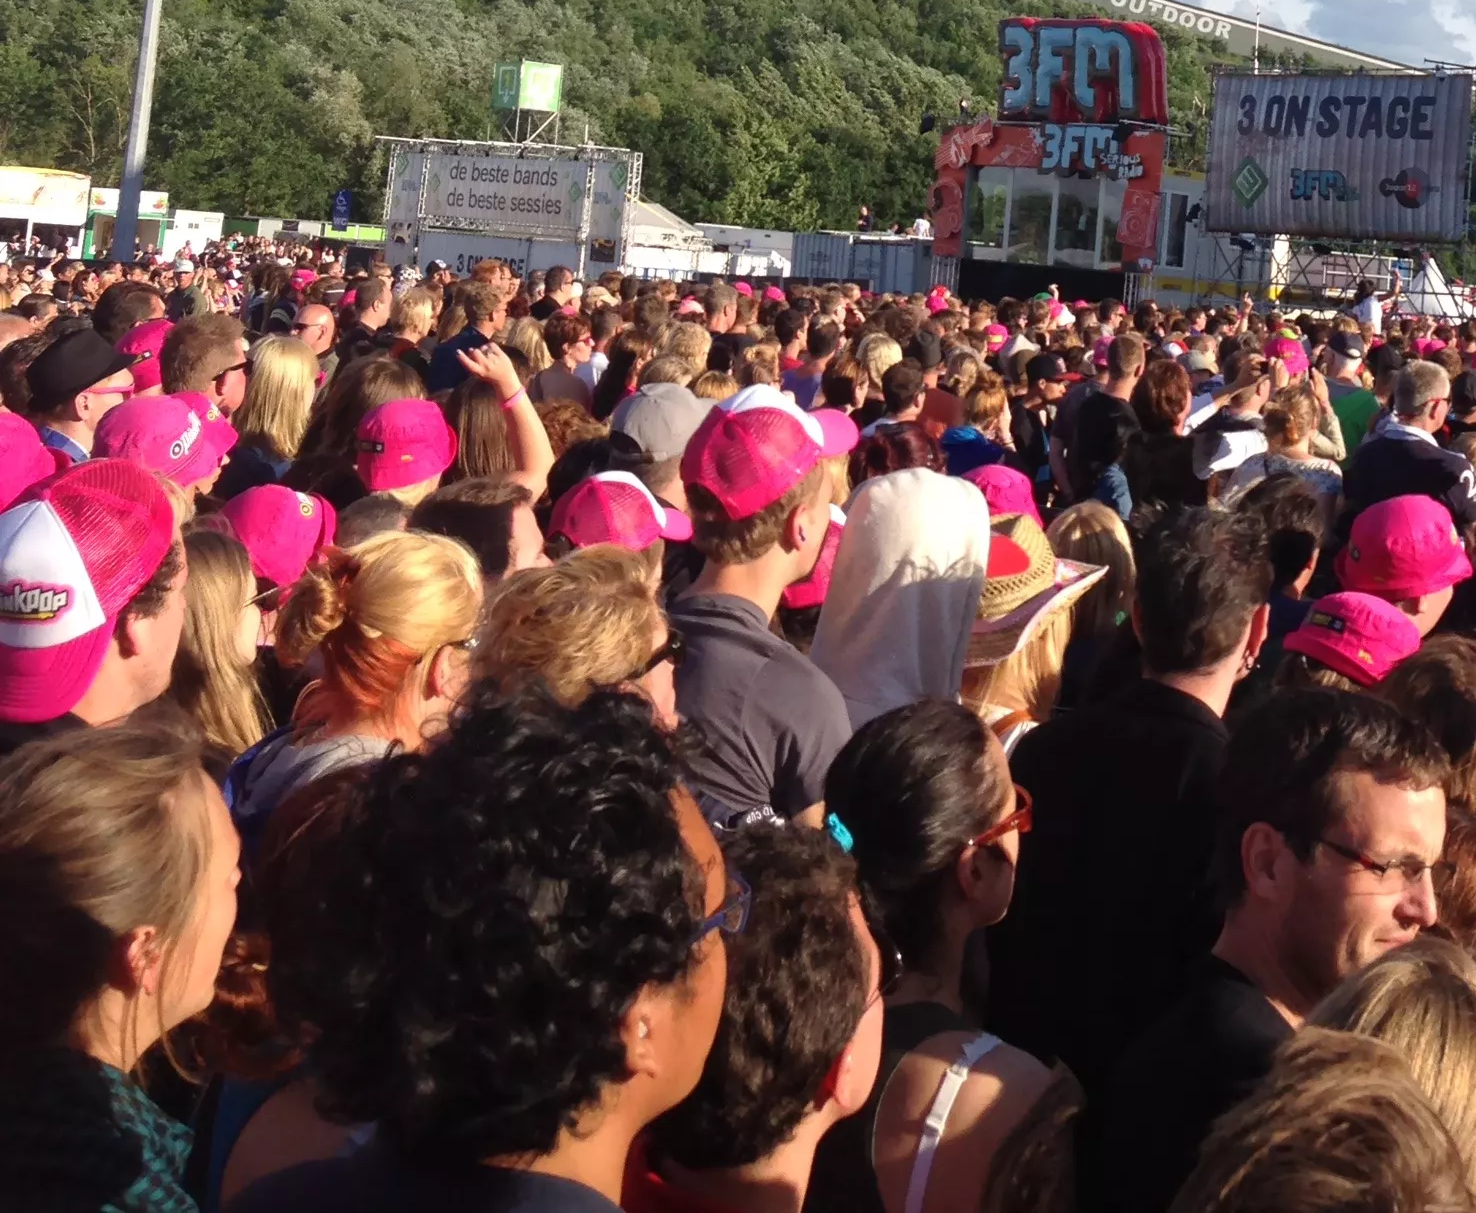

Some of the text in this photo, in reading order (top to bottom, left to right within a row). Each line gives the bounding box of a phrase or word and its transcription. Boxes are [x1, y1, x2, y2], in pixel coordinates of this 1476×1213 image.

[1002, 25, 1134, 109] 3FM
[1238, 94, 1437, 140] 3 ON STAGE
[1042, 124, 1118, 169] 3FM
[450, 162, 558, 186] de beste bands
[1290, 168, 1347, 201] 3FM
[447, 188, 562, 215] de beste sessies
[456, 253, 465, 273] 3
